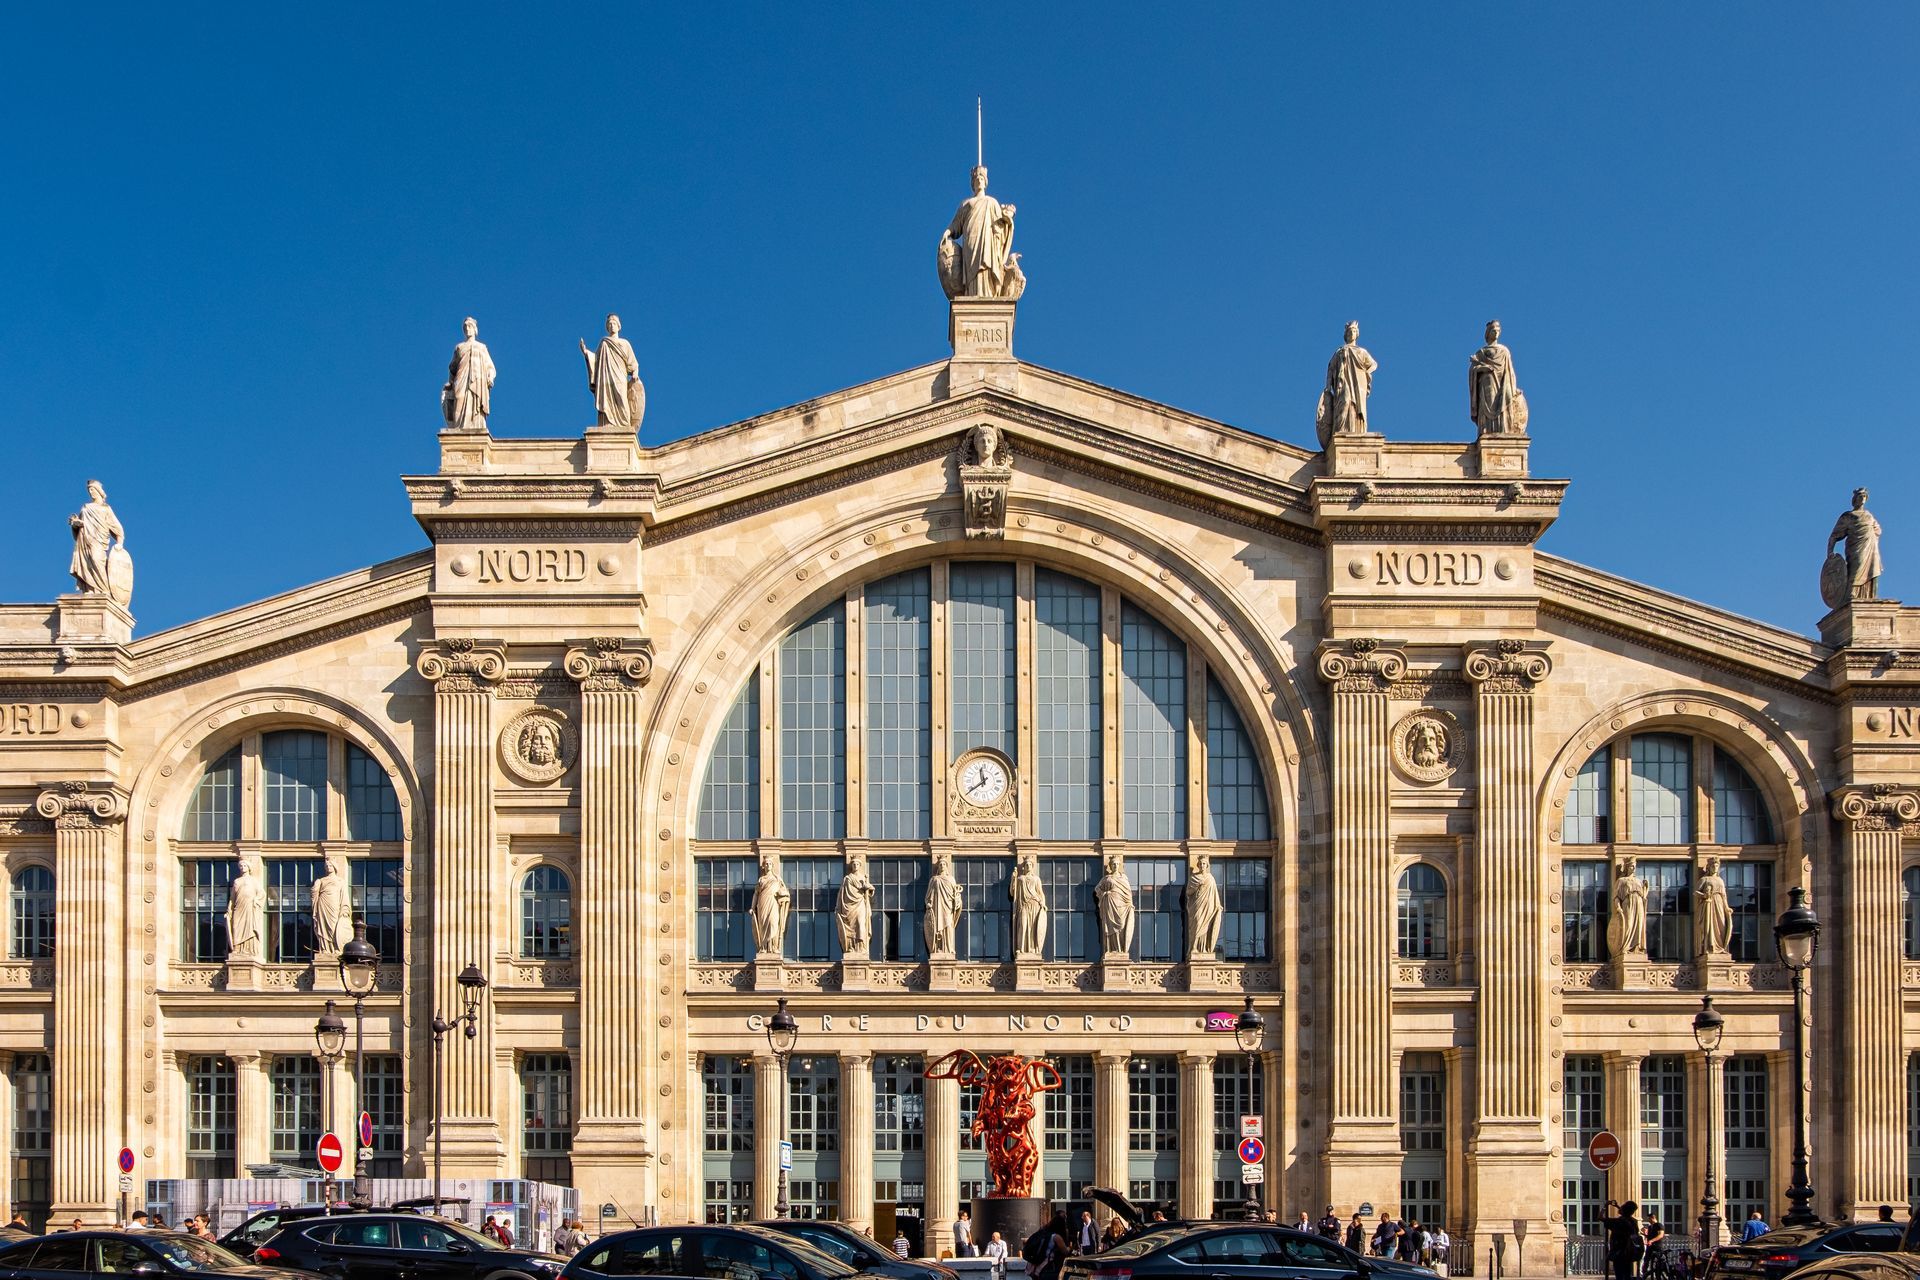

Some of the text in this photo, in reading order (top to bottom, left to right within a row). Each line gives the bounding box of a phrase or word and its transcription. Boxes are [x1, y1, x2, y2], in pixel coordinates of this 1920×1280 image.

[965, 328, 1003, 343] PARIS
[477, 549, 588, 583] NORD
[1375, 550, 1484, 586] NORD
[1888, 707, 1920, 738] N
[746, 1014, 1132, 1032] GRE DU NORD
[1209, 1018, 1239, 1028] SNCF
